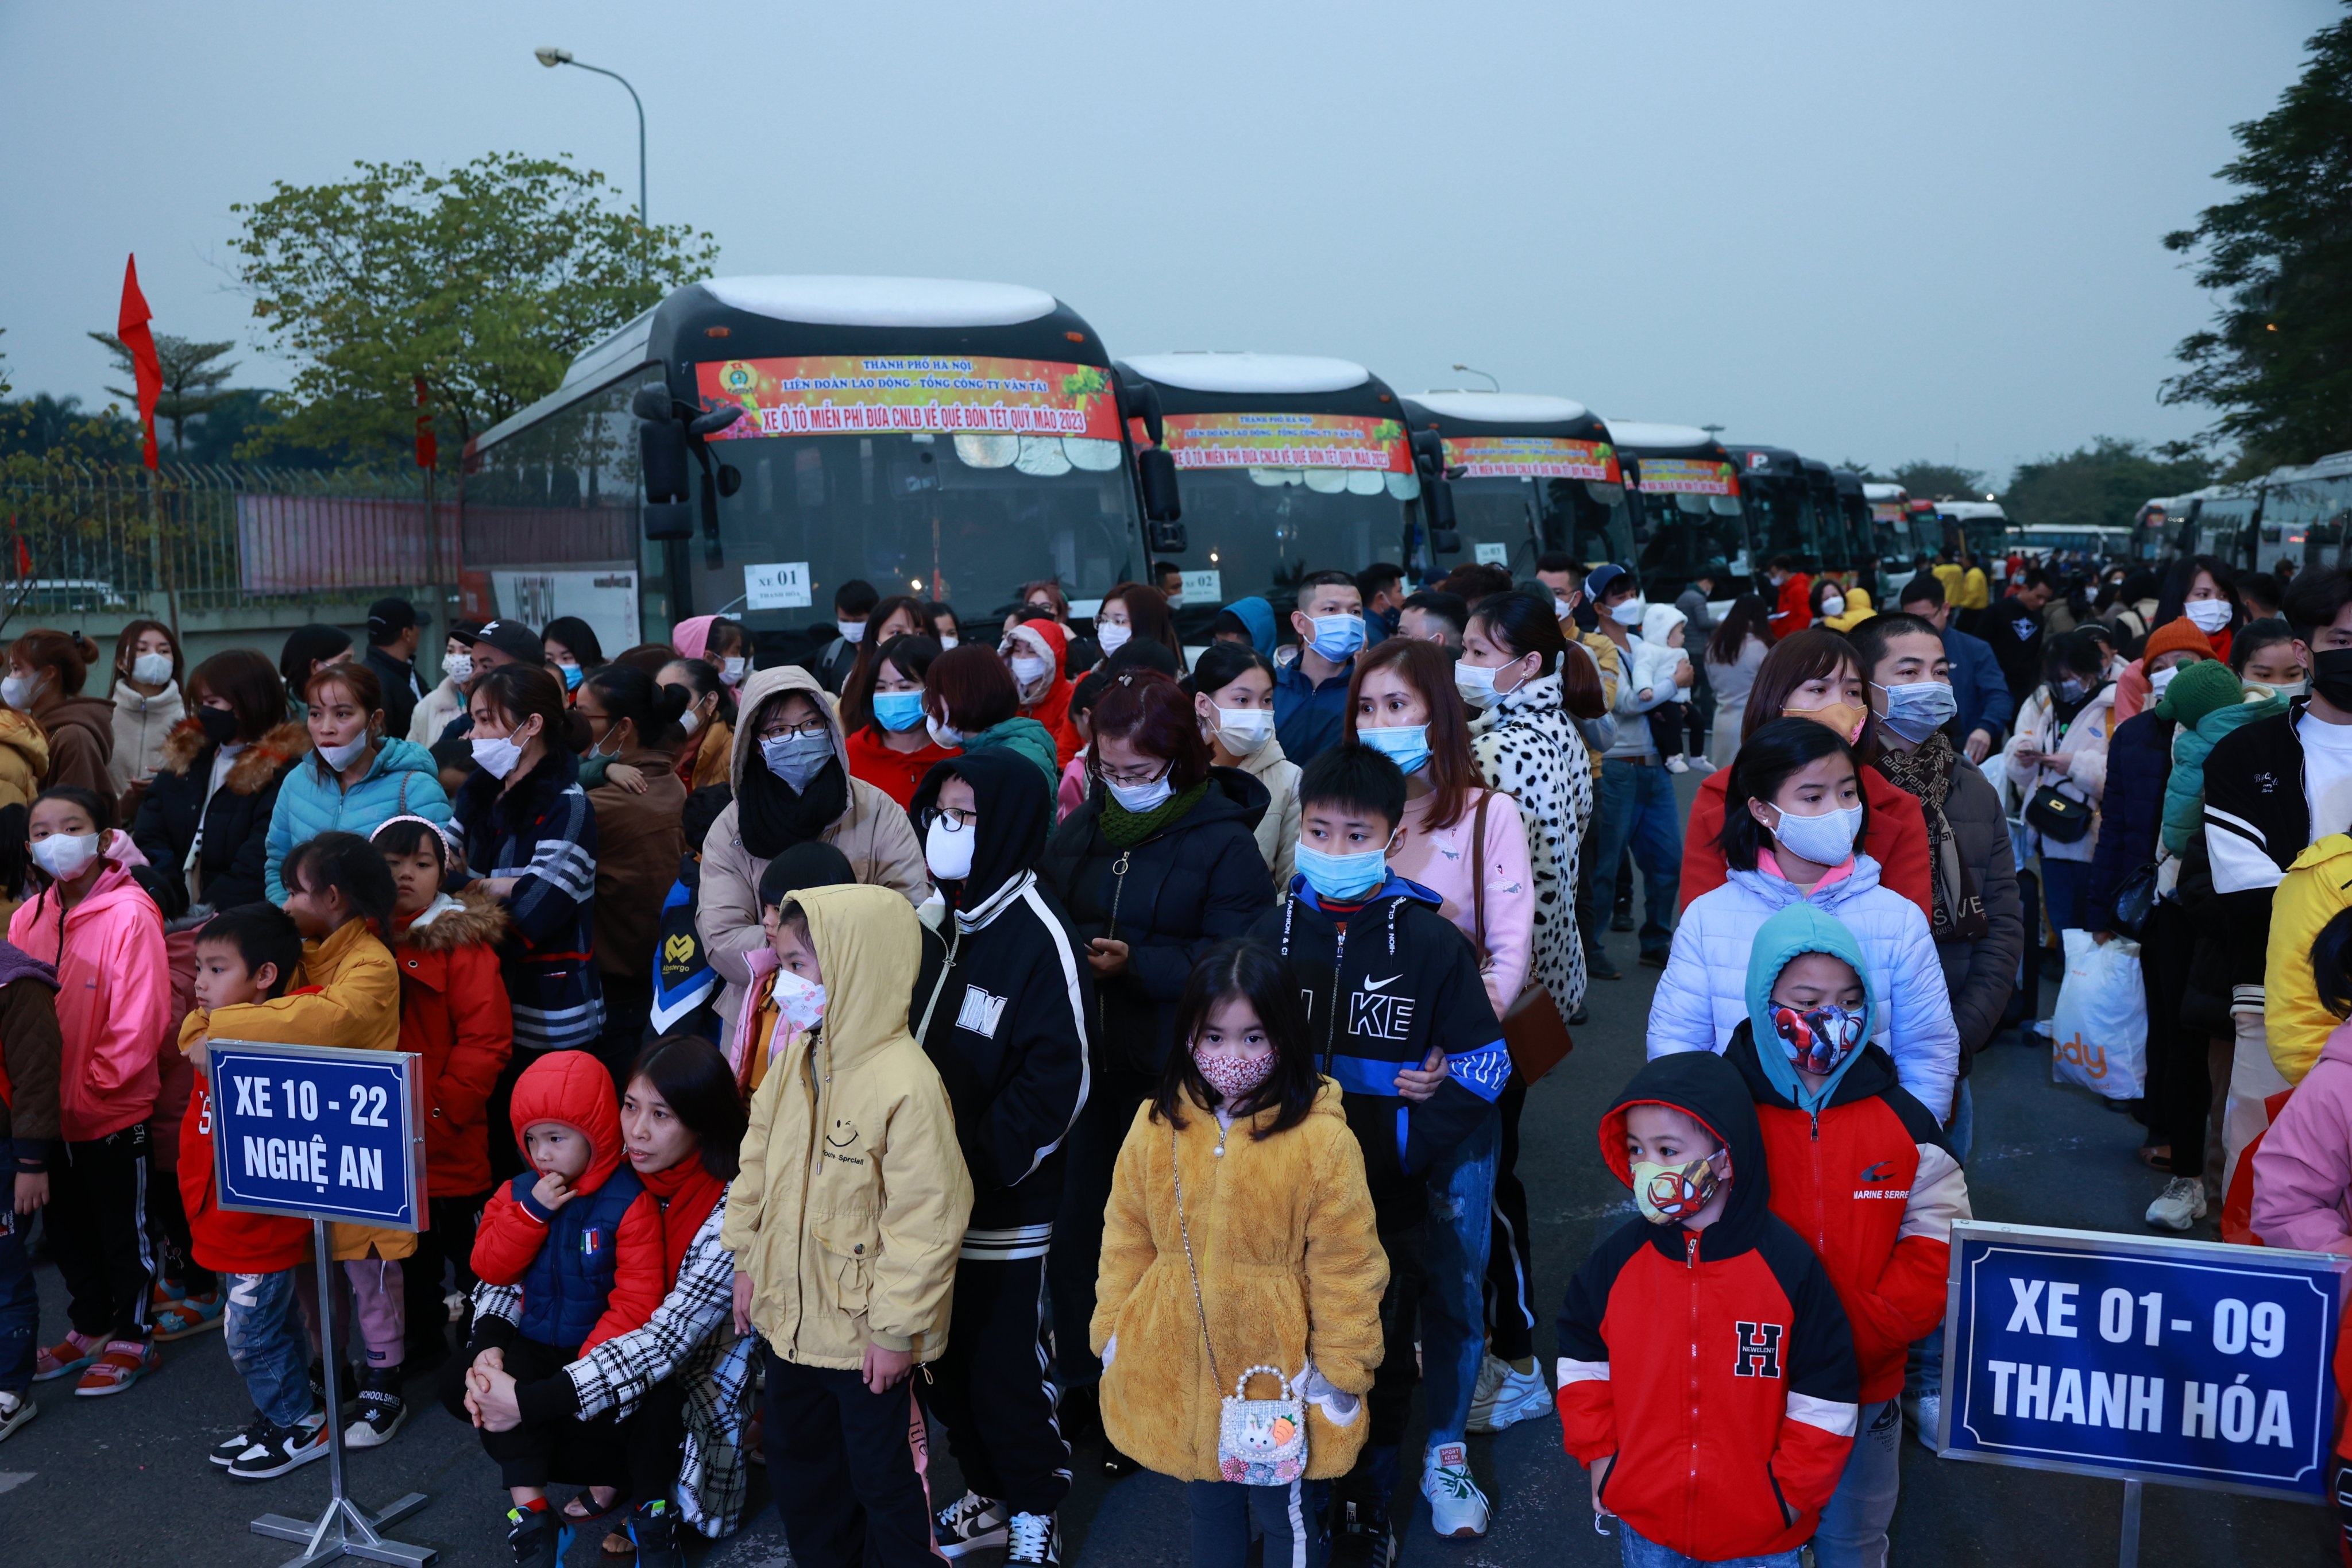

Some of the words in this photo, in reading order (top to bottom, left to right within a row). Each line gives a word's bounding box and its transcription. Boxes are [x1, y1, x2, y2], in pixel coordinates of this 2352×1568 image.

[863, 358, 903, 370] THÀNH
[907, 357, 930, 369] PHỐ
[933, 360, 948, 370] HÀ
[952, 361, 972, 373] NỘI
[783, 377, 810, 391] LIÊN
[814, 377, 848, 389] ĐOÀN
[852, 379, 874, 388] LAO
[878, 377, 910, 391] ĐỘNG
[920, 375, 950, 388] TỔNG
[954, 377, 983, 389] CÔNG
[987, 380, 1000, 389] TY
[1005, 379, 1026, 392] VẬN
[763, 409, 778, 431] XE
[782, 405, 789, 429] Ô
[793, 405, 806, 428] TÔ
[810, 401, 841, 428] MIỄN
[845, 404, 864, 427] PHÍ
[867, 407, 889, 427] ĐƯA
[893, 408, 921, 427] CNLĐ
[941, 404, 961, 430] QUÊ
[965, 404, 987, 427] ĐÓN
[990, 402, 1007, 428] TẾT
[1011, 405, 1030, 431] QUÝ
[1060, 412, 1084, 431] 2023
[759, 577, 773, 586] XE
[777, 570, 797, 585] 01
[1198, 576, 1212, 586] 02
[1284, 899, 1293, 934] FASHION
[662, 964, 690, 972] Abstergo
[233, 1075, 273, 1118] XE
[281, 1079, 318, 1121] 10
[328, 1100, 340, 1110] -
[349, 1084, 388, 1127] 22
[244, 1134, 329, 1194] NGHỆ
[338, 1145, 383, 1191] AN
[1853, 1190, 1883, 1199] MARINE
[1884, 1190, 1910, 1199] SERRE
[2005, 1277, 2080, 1338] XE
[2212, 1297, 2286, 1359] 09
[1735, 1320, 1783, 1379] H
[1742, 1346, 1775, 1354] NEWELENT
[1988, 1359, 2164, 1434] THANH
[2181, 1373, 2294, 1449] HÓA
